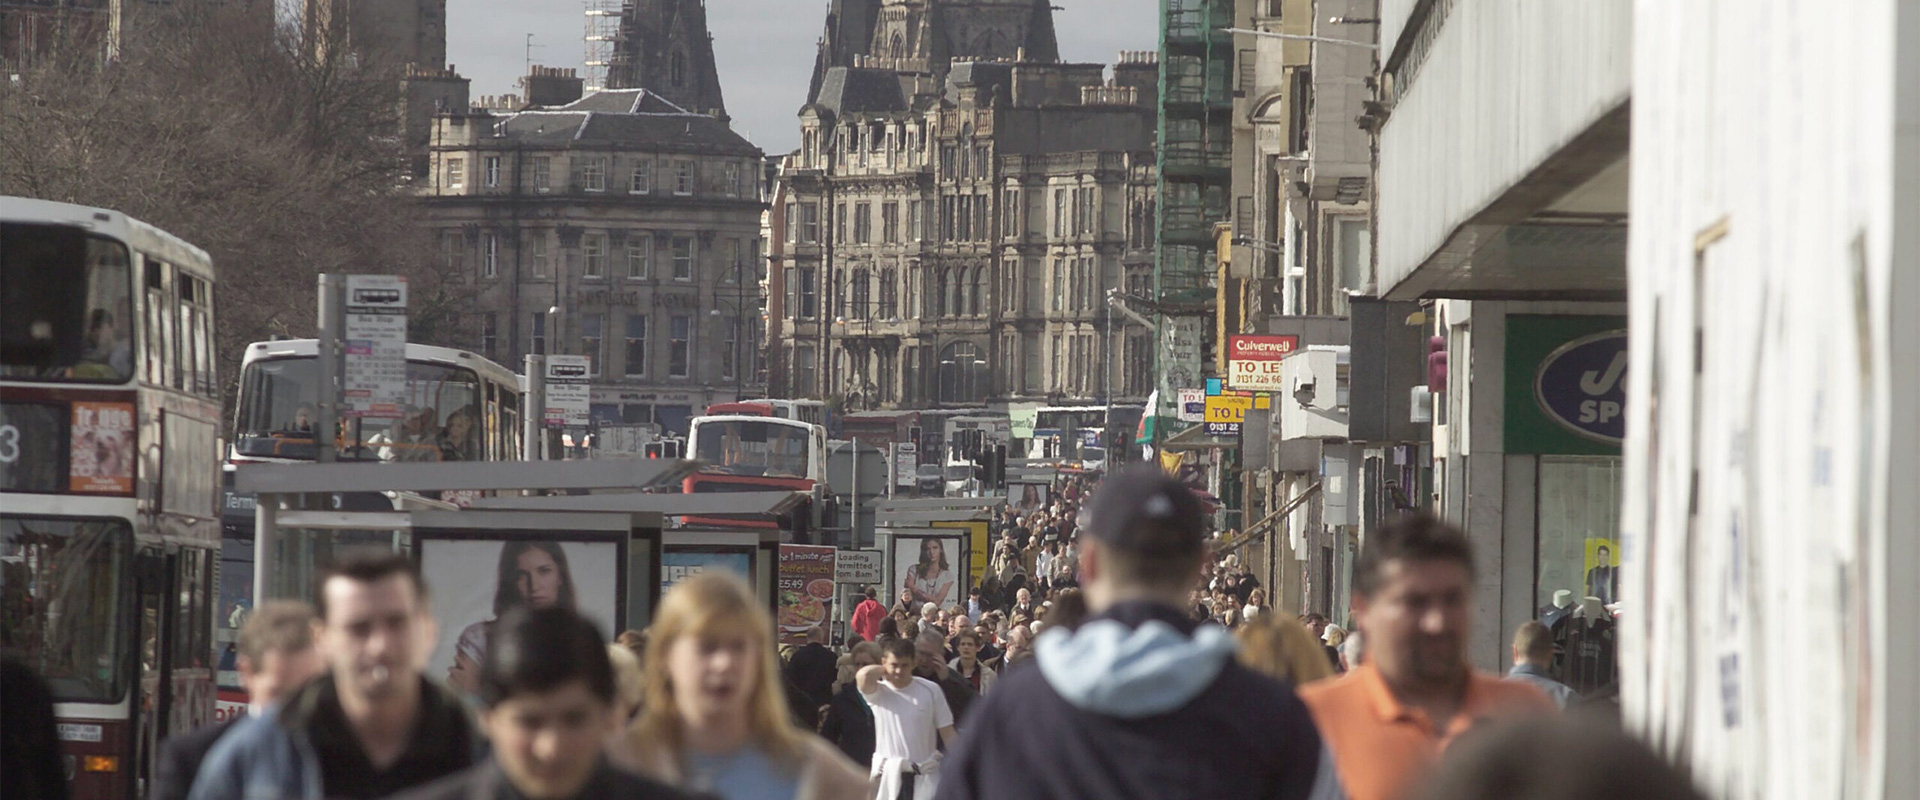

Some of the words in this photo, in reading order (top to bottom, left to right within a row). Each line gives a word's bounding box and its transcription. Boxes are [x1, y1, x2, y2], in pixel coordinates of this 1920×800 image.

[1236, 340, 1290, 351] Culverwell
[1236, 361, 1256, 373] TO
[1236, 374, 1253, 383] 0131
[1255, 375, 1270, 384] 226
[1271, 374, 1283, 384] 66
[1212, 407, 1231, 419] TO
[1579, 399, 1626, 423] SP
[1209, 422, 1227, 431] 0131
[1228, 423, 1239, 431] 22
[779, 552, 789, 561] he
[838, 553, 869, 562] Loading
